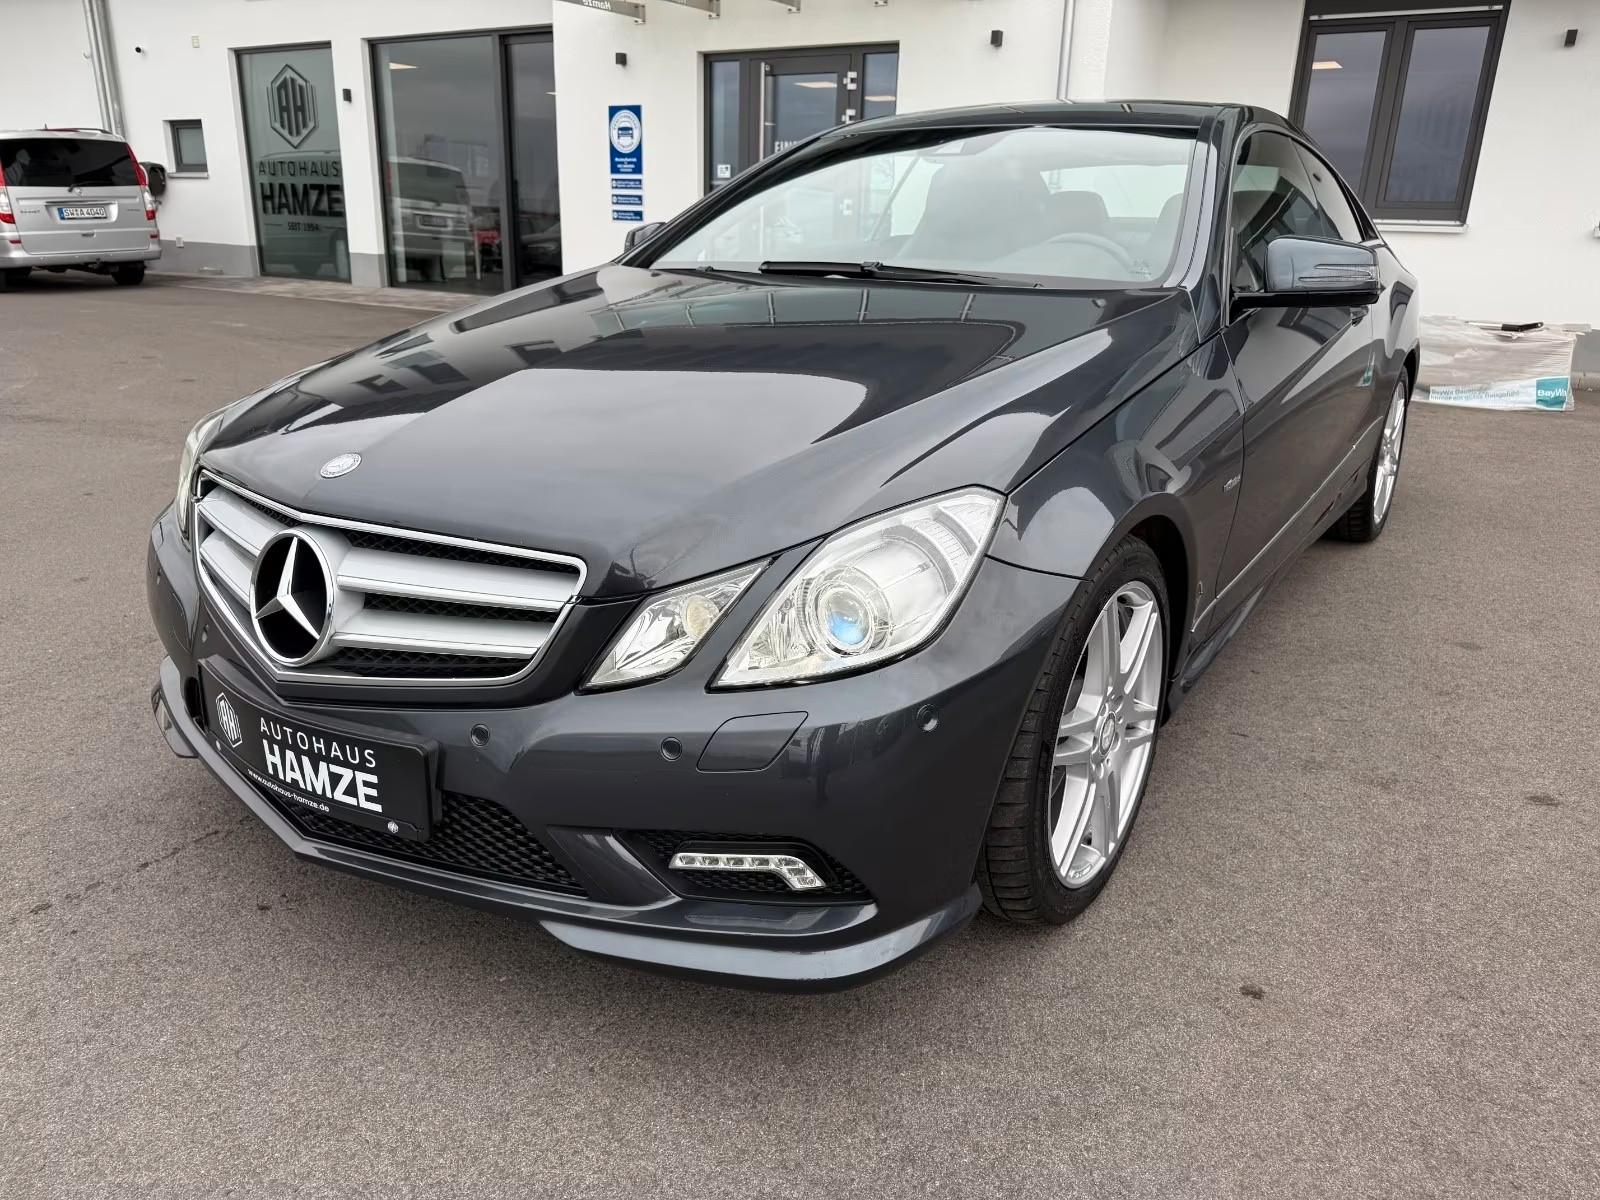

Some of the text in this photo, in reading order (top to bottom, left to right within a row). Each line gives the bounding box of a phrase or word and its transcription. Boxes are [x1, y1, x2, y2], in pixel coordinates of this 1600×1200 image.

[259, 160, 340, 177] AUTOHAUS
[259, 182, 344, 217] HAMZE
[260, 717, 376, 768] AUTOHAUS
[263, 738, 382, 813] HAMZE
